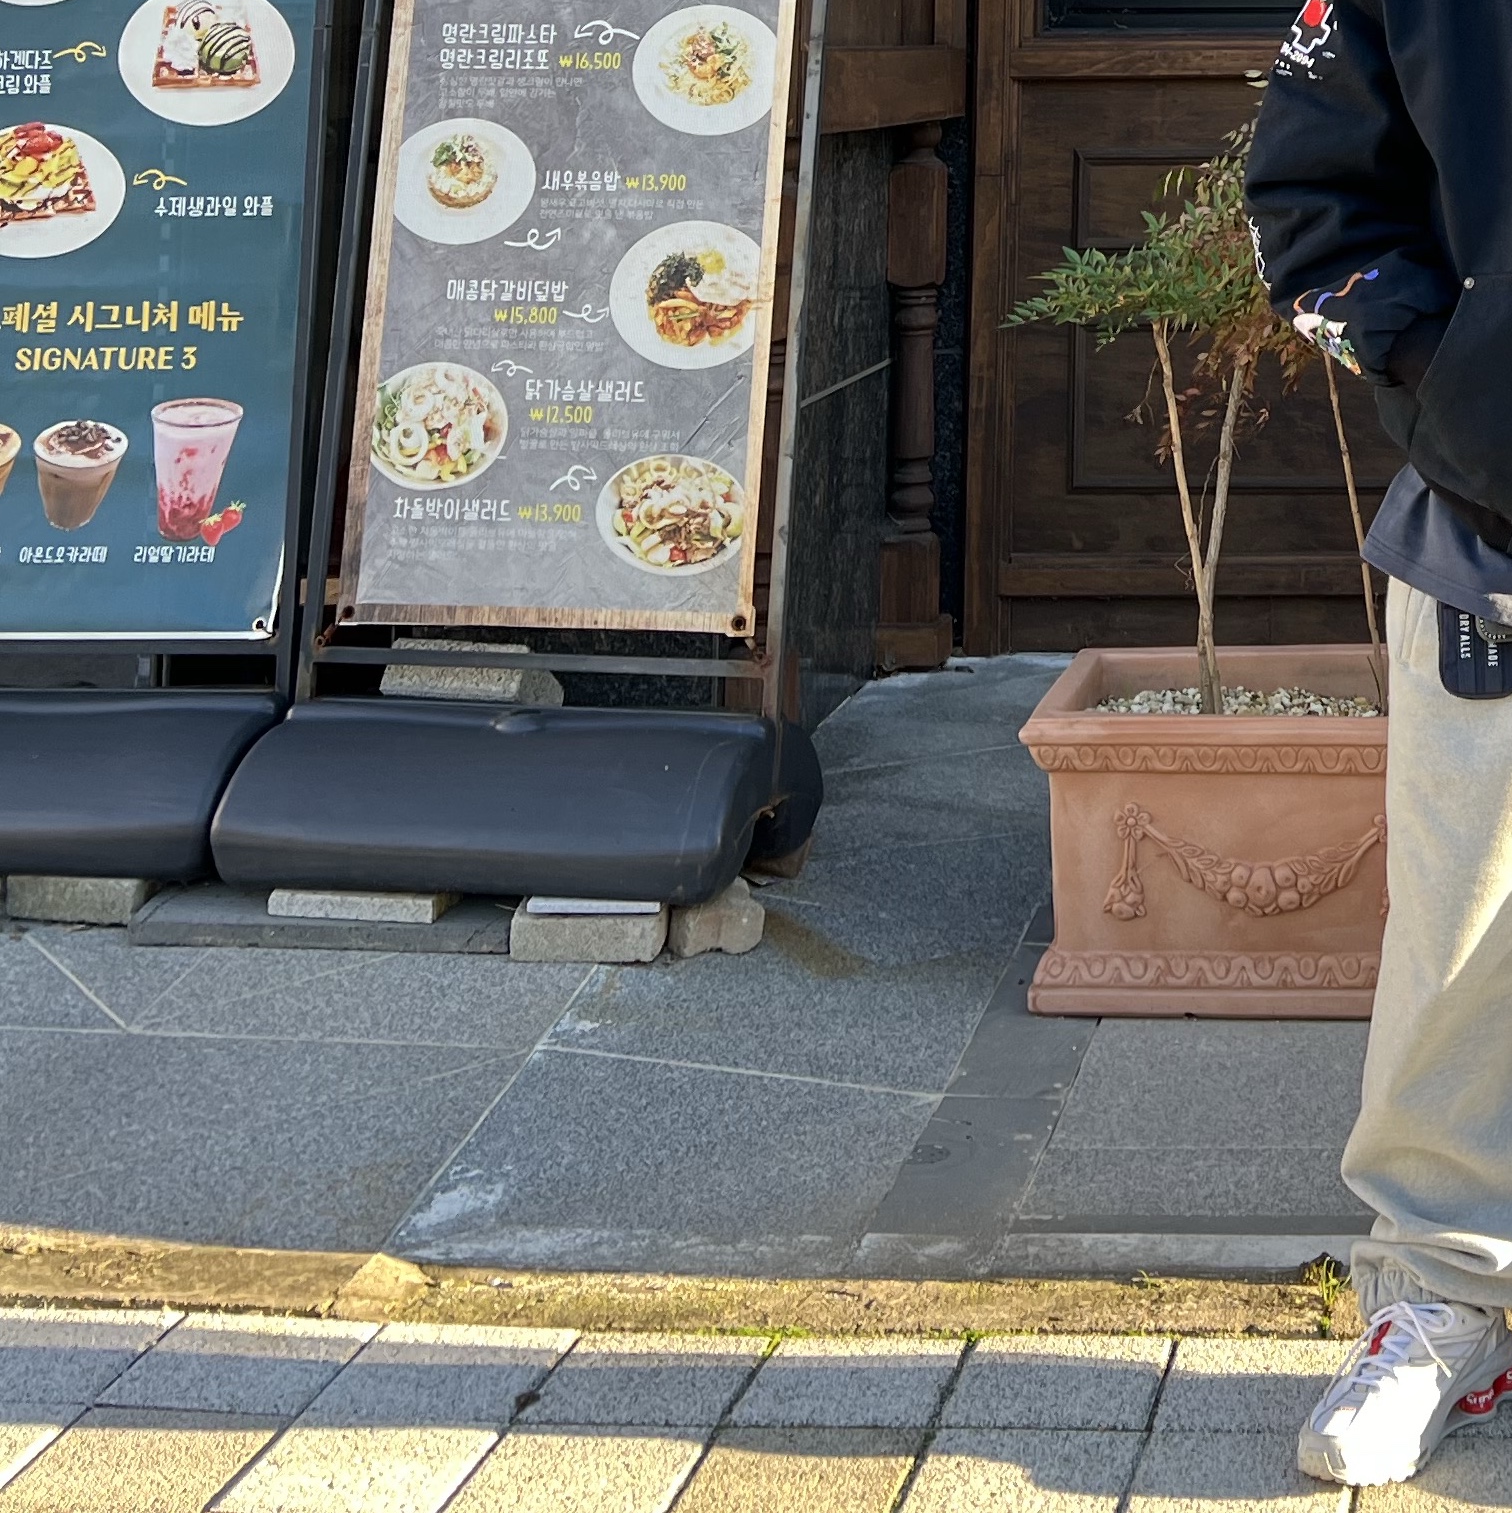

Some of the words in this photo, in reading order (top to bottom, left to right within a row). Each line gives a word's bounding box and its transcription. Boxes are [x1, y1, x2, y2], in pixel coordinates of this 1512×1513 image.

[442, 23, 557, 45] 명란크림파스타
[439, 48, 550, 71] 명란크림리조또
[22, 74, 52, 95] 와플
[541, 169, 622, 192] 새우볶음밥
[154, 197, 237, 218] 수제생과일
[242, 196, 275, 217] 와플
[447, 278, 569, 302] 매콤닭갈비덮밥
[0, 301, 59, 334] 페셜
[67, 300, 179, 333] 시그니처
[188, 300, 245, 333] 메뉴
[15, 346, 174, 372] SIGNATURE
[180, 346, 198, 370] 3
[526, 379, 646, 403] 닭가슴살샐러드
[392, 497, 511, 521] 차돌박이샐러드
[1459, 613, 1471, 633] DRY
